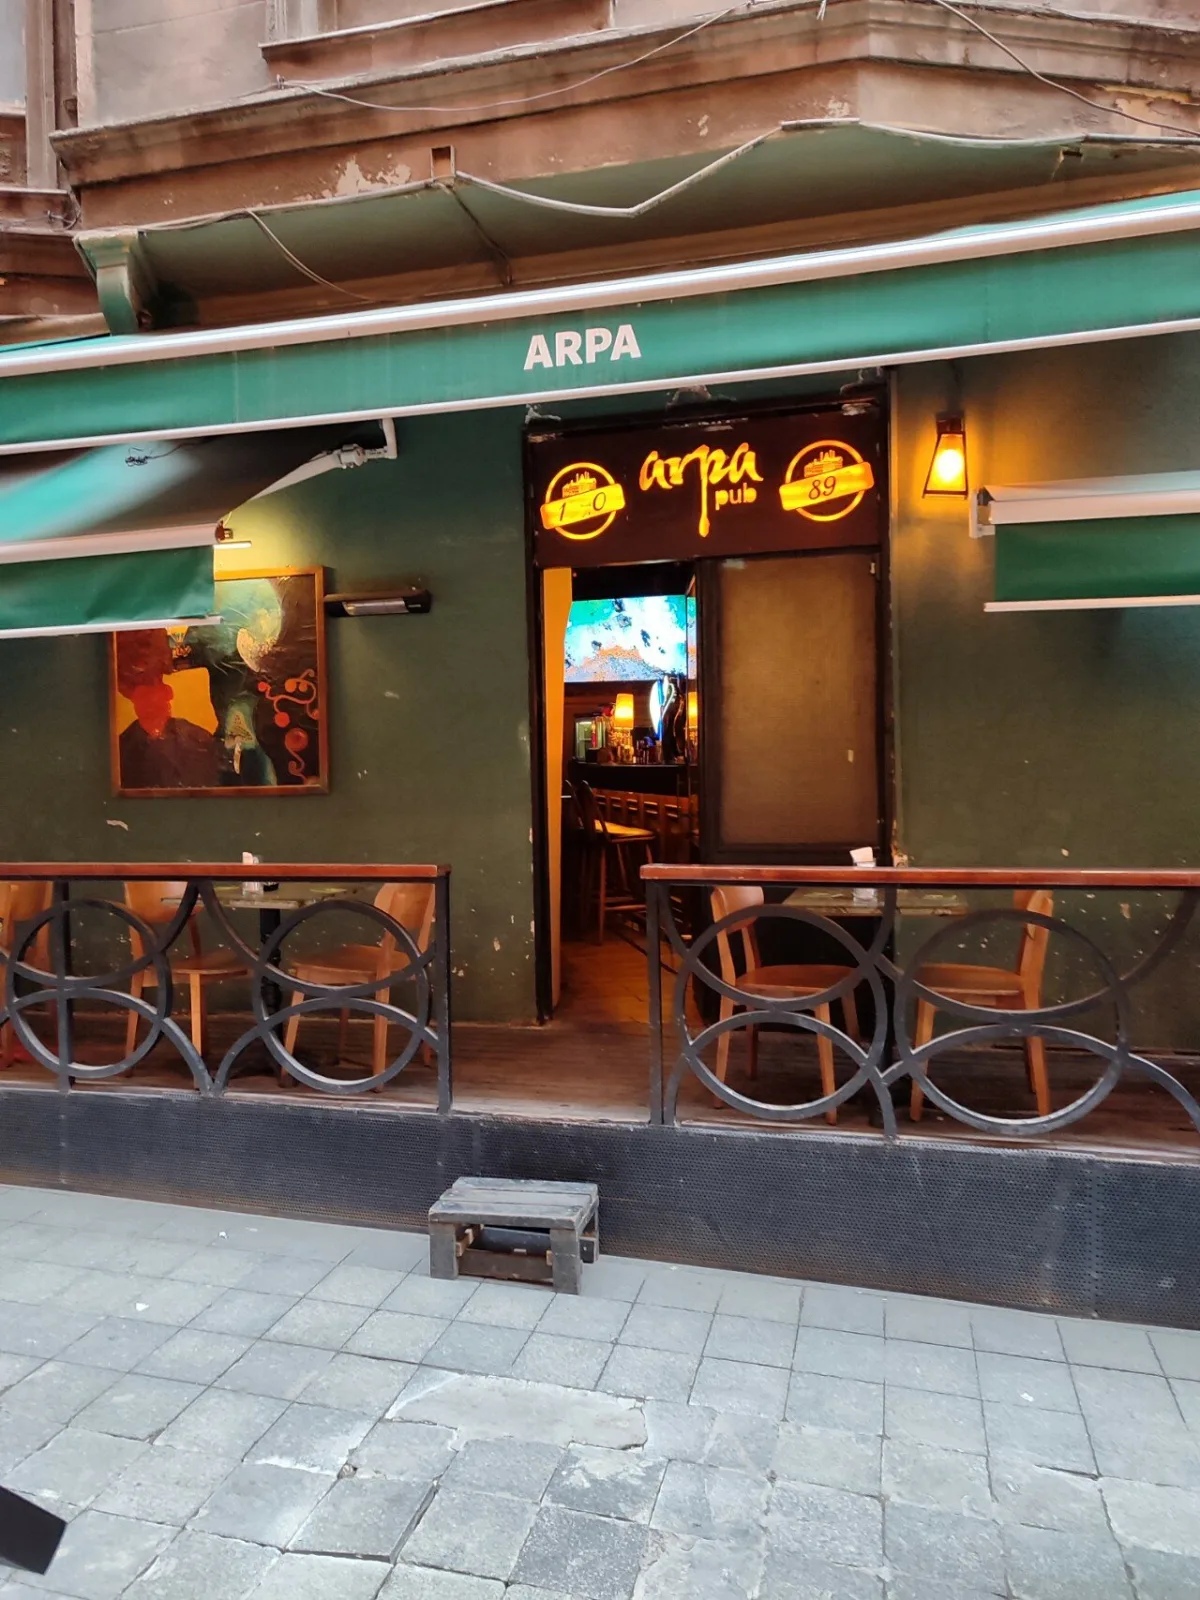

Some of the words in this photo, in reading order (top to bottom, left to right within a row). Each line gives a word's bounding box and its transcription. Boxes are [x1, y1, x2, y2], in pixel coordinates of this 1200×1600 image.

[523, 324, 641, 370] ARPA
[639, 442, 764, 537] arpa
[715, 482, 757, 511] pub
[808, 476, 837, 500] 89
